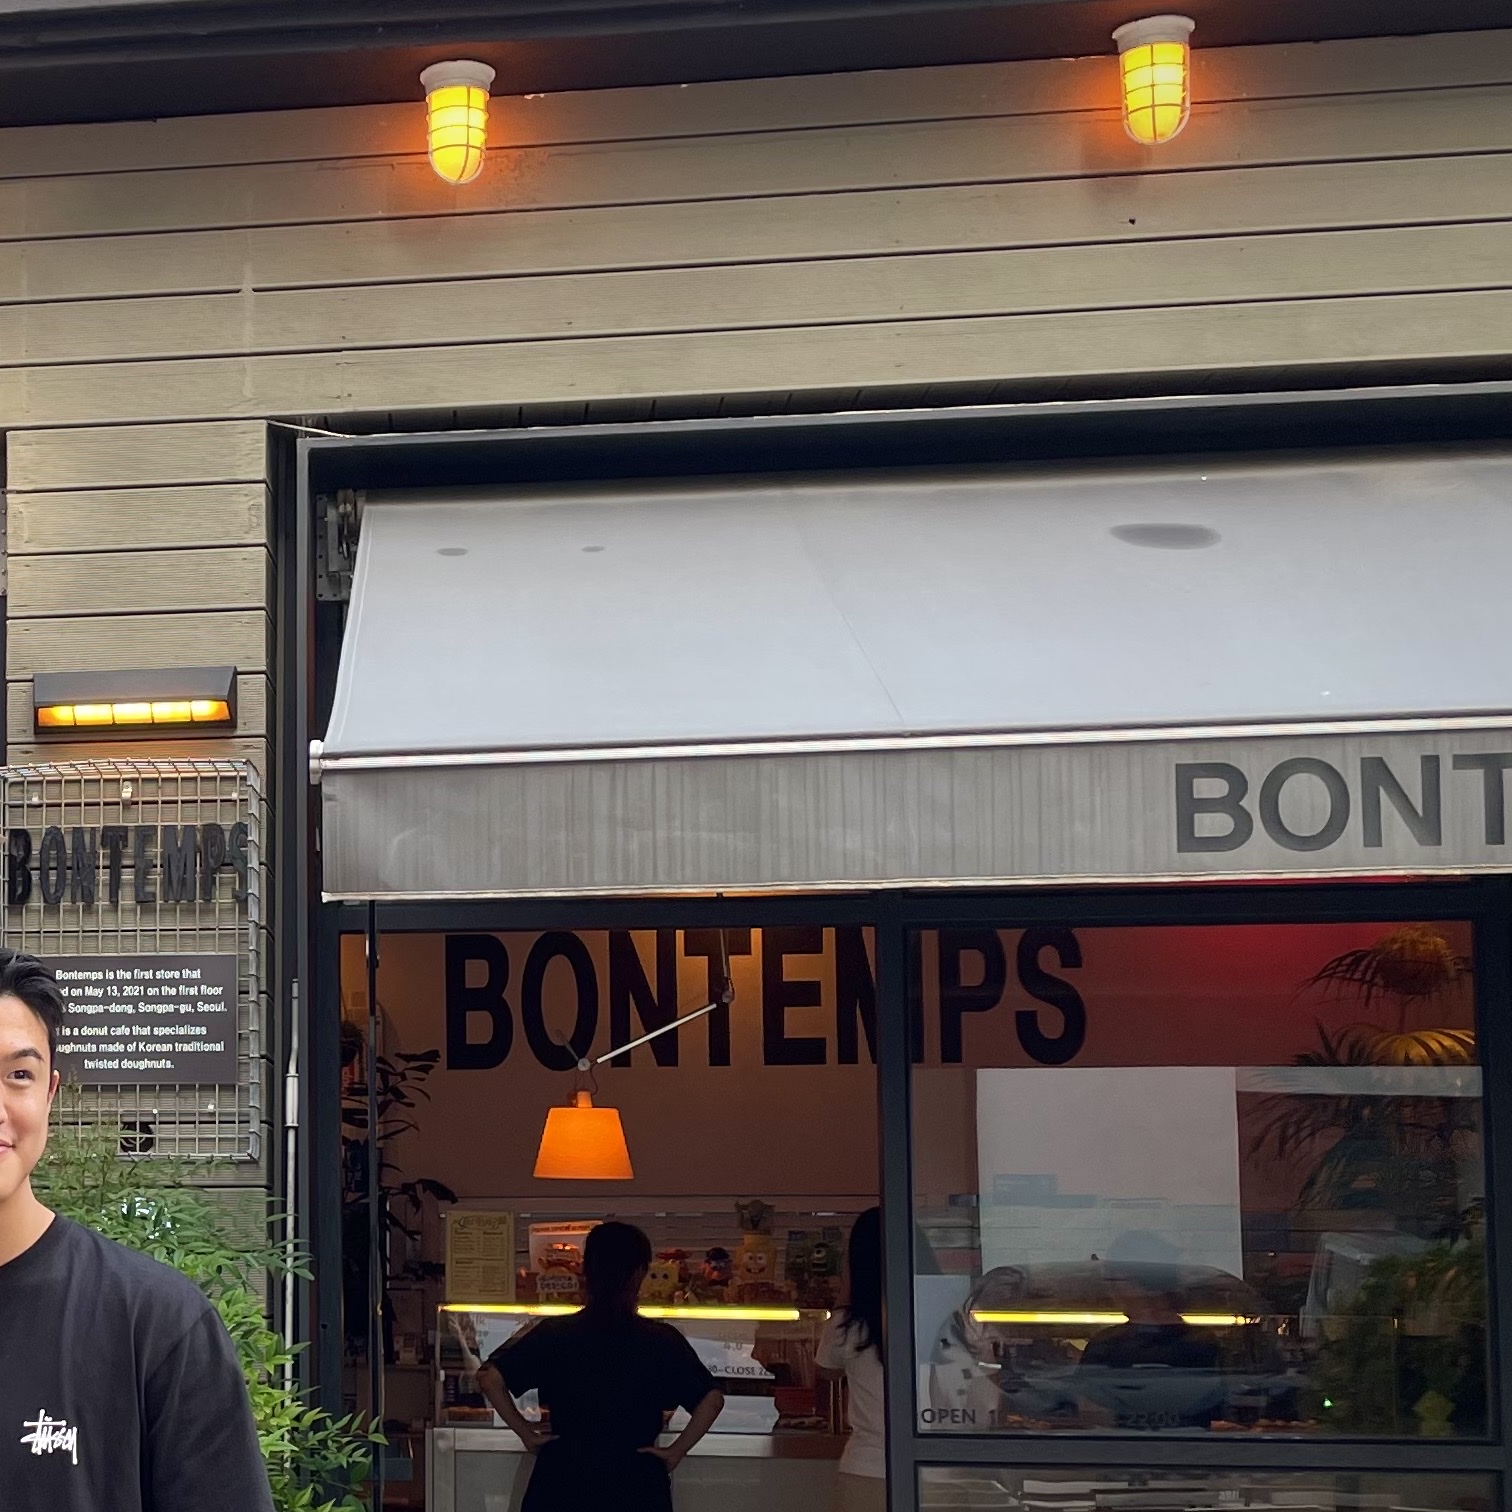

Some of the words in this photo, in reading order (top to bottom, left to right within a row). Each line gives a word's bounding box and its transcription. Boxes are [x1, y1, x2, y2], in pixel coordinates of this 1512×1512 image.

[7, 822, 249, 906] BONTEMPS
[55, 969, 104, 982] Bontemps
[105, 969, 115, 980] is
[116, 969, 132, 980] the
[133, 968, 154, 980] first
[155, 969, 181, 980] store
[182, 968, 202, 979] that
[70, 987, 83, 997] on
[84, 986, 104, 998] May
[106, 985, 121, 998] 13,
[122, 985, 145, 997] 2021
[146, 987, 160, 996] on
[161, 985, 177, 996] the
[178, 985, 199, 996] first
[200, 984, 224, 996] floor
[196, 1001, 228, 1013] Seoul.
[61, 1026, 72, 1037] is
[72, 1027, 80, 1036] a
[80, 1026, 109, 1036] donut
[110, 1025, 131, 1036] cafe
[131, 1025, 151, 1036] that
[152, 1025, 207, 1037] specializes
[98, 1042, 125, 1053] made
[126, 1041, 137, 1053] of
[138, 1042, 173, 1053] Korean
[174, 1041, 225, 1053] traditional
[83, 1059, 120, 1070] twisted
[120, 1059, 175, 1071] doughnuts.
[921, 1407, 976, 1424] OPEN
